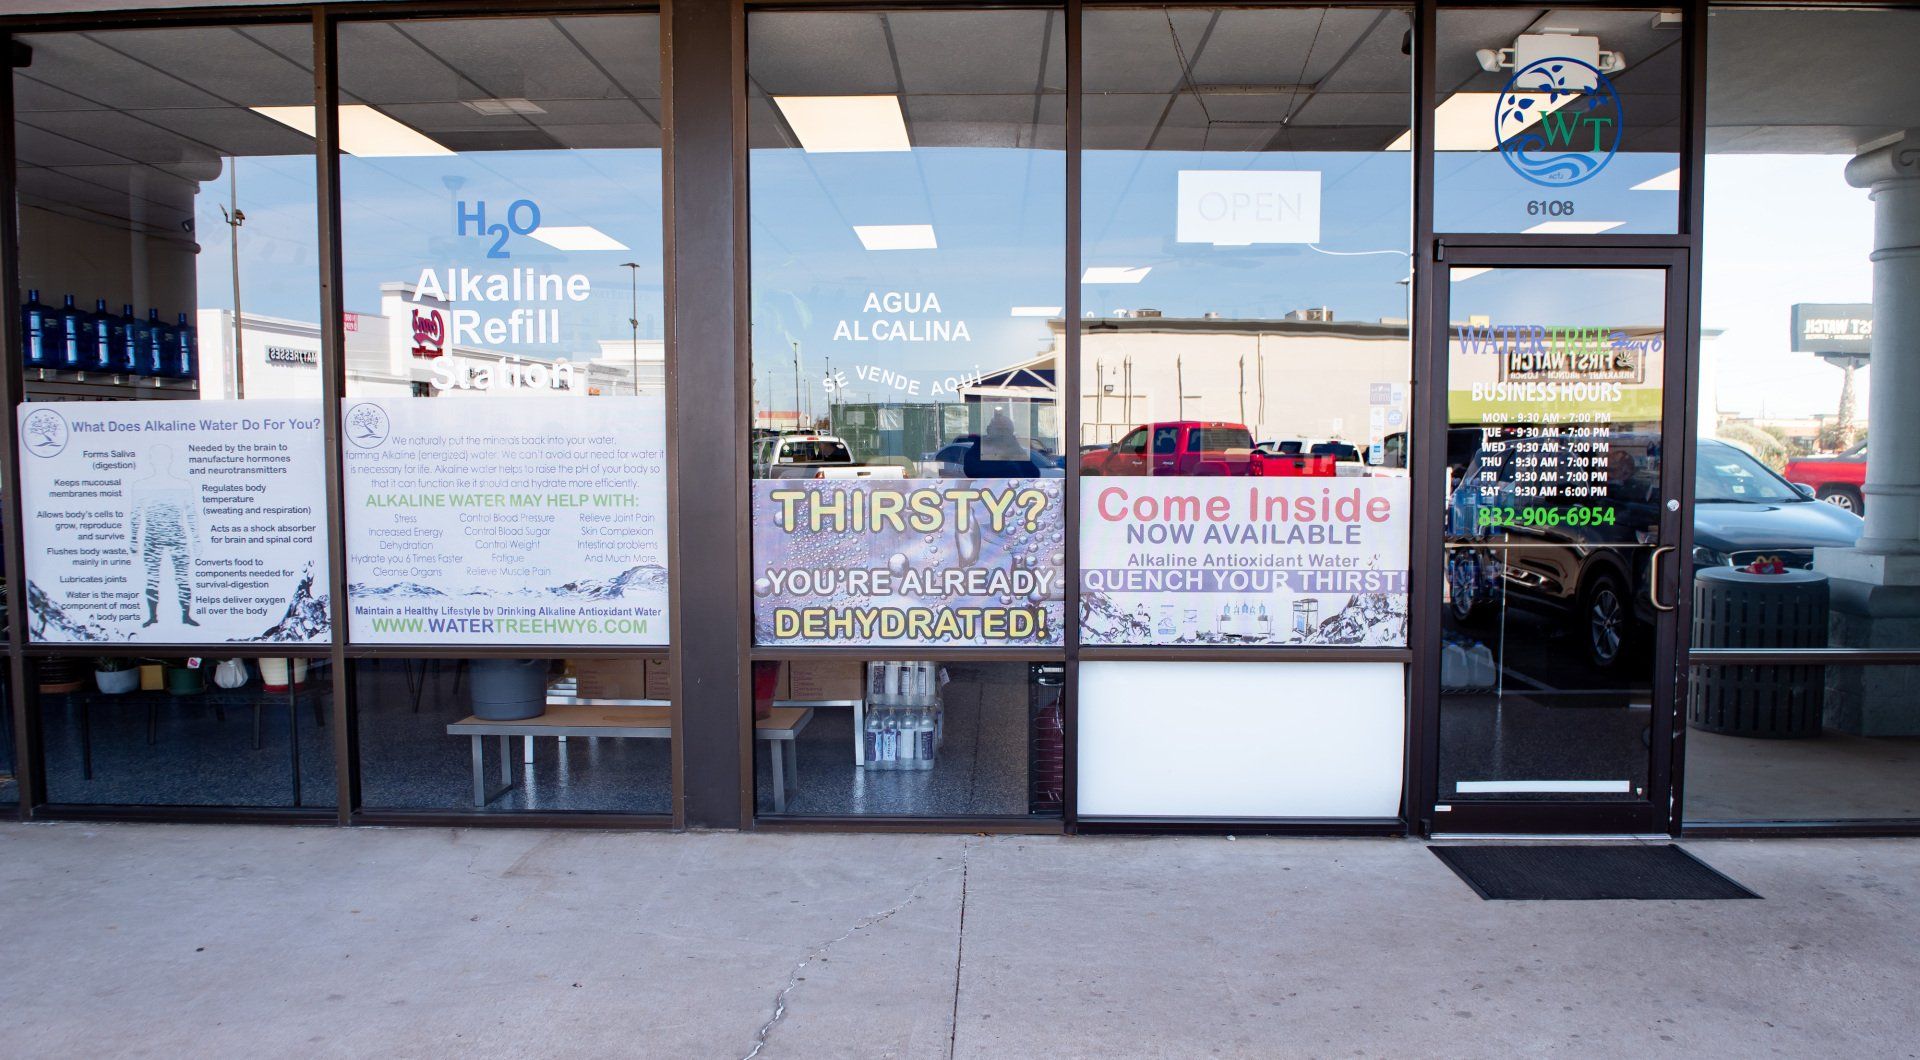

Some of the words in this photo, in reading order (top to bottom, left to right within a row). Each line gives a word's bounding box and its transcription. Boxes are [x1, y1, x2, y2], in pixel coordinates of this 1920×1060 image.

[1540, 110, 1611, 152] WT
[1199, 192, 1301, 221] OPEN
[1527, 200, 1574, 216] 6108
[457, 200, 541, 258] H2O
[413, 268, 590, 301] Alkaline
[863, 292, 941, 313] AGUA
[454, 309, 559, 344] Refill
[833, 320, 971, 341] ALCALINA
[1651, 339, 1661, 352] 6
[430, 356, 573, 391] Station
[822, 371, 848, 393] SE
[855, 365, 920, 395] VENDE
[1472, 383, 1556, 401] BUSINESS
[1561, 383, 1622, 401] HOURS
[1482, 413, 1508, 422] MON
[1518, 413, 1539, 422] 9:30
[1542, 413, 1559, 422] AM
[1569, 413, 1590, 422] 7:00
[1595, 413, 1610, 422] PM
[72, 421, 105, 432] What
[109, 421, 141, 432] Does
[145, 420, 196, 431] Alkaline
[200, 420, 238, 430] Water
[242, 419, 260, 430] Do
[264, 419, 285, 429] For
[289, 418, 320, 429] You?
[1482, 428, 1501, 437] TUE
[1517, 428, 1539, 437] 9:30
[1542, 428, 1559, 437] AM
[1569, 428, 1589, 437] 7:00
[1593, 428, 1609, 437] PM
[225, 444, 235, 453] by
[1482, 443, 1505, 452] WED
[1517, 443, 1538, 452] 9:30
[1541, 443, 1558, 452] AM
[1568, 443, 1589, 452] 7:00
[1593, 443, 1608, 452] PM
[93, 462, 136, 470] (digestion)
[1481, 458, 1502, 466] THU
[1516, 457, 1537, 466] 9:30
[1541, 458, 1558, 466] AM
[1567, 458, 1588, 466] 7:00
[1592, 458, 1608, 466] PM
[208, 466, 287, 474] neurotransmitters
[1481, 473, 1497, 481] FRI
[1515, 472, 1537, 481] 9:30
[1540, 473, 1557, 481] AM
[1566, 472, 1588, 481] 7:00
[1591, 472, 1607, 481] PM
[54, 479, 79, 487] Keeps
[202, 485, 243, 493] Regulates
[246, 484, 266, 493] body
[1481, 487, 1499, 496] SAT
[1515, 487, 1536, 496] 9:30
[1539, 487, 1556, 496] AM
[1565, 487, 1587, 496] 6:00
[1590, 487, 1607, 496] PM
[203, 496, 254, 504] temperature
[366, 494, 446, 507] ALKALINE
[449, 494, 506, 507] WATER
[510, 494, 542, 506] MAY
[547, 494, 589, 506] HELP
[593, 494, 639, 506] WITH:
[1098, 487, 1230, 522] Come
[1250, 487, 1390, 522] Inside
[203, 507, 243, 515] (sweating
[263, 506, 311, 515] respiration)
[770, 488, 1047, 533] THIRSTY?
[1479, 507, 1615, 525] 832-906-6954
[394, 514, 417, 523] Stress
[414, 528, 443, 538] Energy
[1127, 523, 1193, 544] NOW
[1203, 524, 1361, 544] AVAILABLE
[266, 536, 290, 545] spinal
[380, 541, 433, 550] Dehydration
[351, 555, 385, 564] Hydrate
[406, 554, 410, 562] 6
[413, 554, 436, 562] Times
[438, 554, 462, 562] Faster
[1128, 554, 1197, 567] Alkaline
[1203, 554, 1303, 567] Antioxidant
[1308, 554, 1359, 567] Water
[373, 567, 408, 576] Cleanse
[411, 567, 442, 578] Organs
[196, 581, 269, 589] survival-digestion
[767, 569, 892, 595] YOU'RE
[900, 569, 1055, 595] ALREADY
[1084, 570, 1202, 591] QUENCH
[1213, 570, 1289, 590] YOUR
[1298, 570, 1408, 591] THIRST!
[196, 596, 220, 605] Helps
[255, 598, 285, 606] oxygen
[246, 607, 267, 616] body
[355, 606, 393, 616] Maintain
[405, 606, 439, 617] Healthy
[442, 606, 480, 617] Lifestyle
[483, 607, 494, 617] by
[497, 607, 536, 618] Drinking
[539, 606, 576, 615] Alkaline
[579, 607, 632, 616] Antioxidant
[634, 607, 661, 616] Water
[372, 619, 647, 633] WWW.WATERTREEHWY6.COM
[774, 607, 1048, 639] DEHYDRATED!
